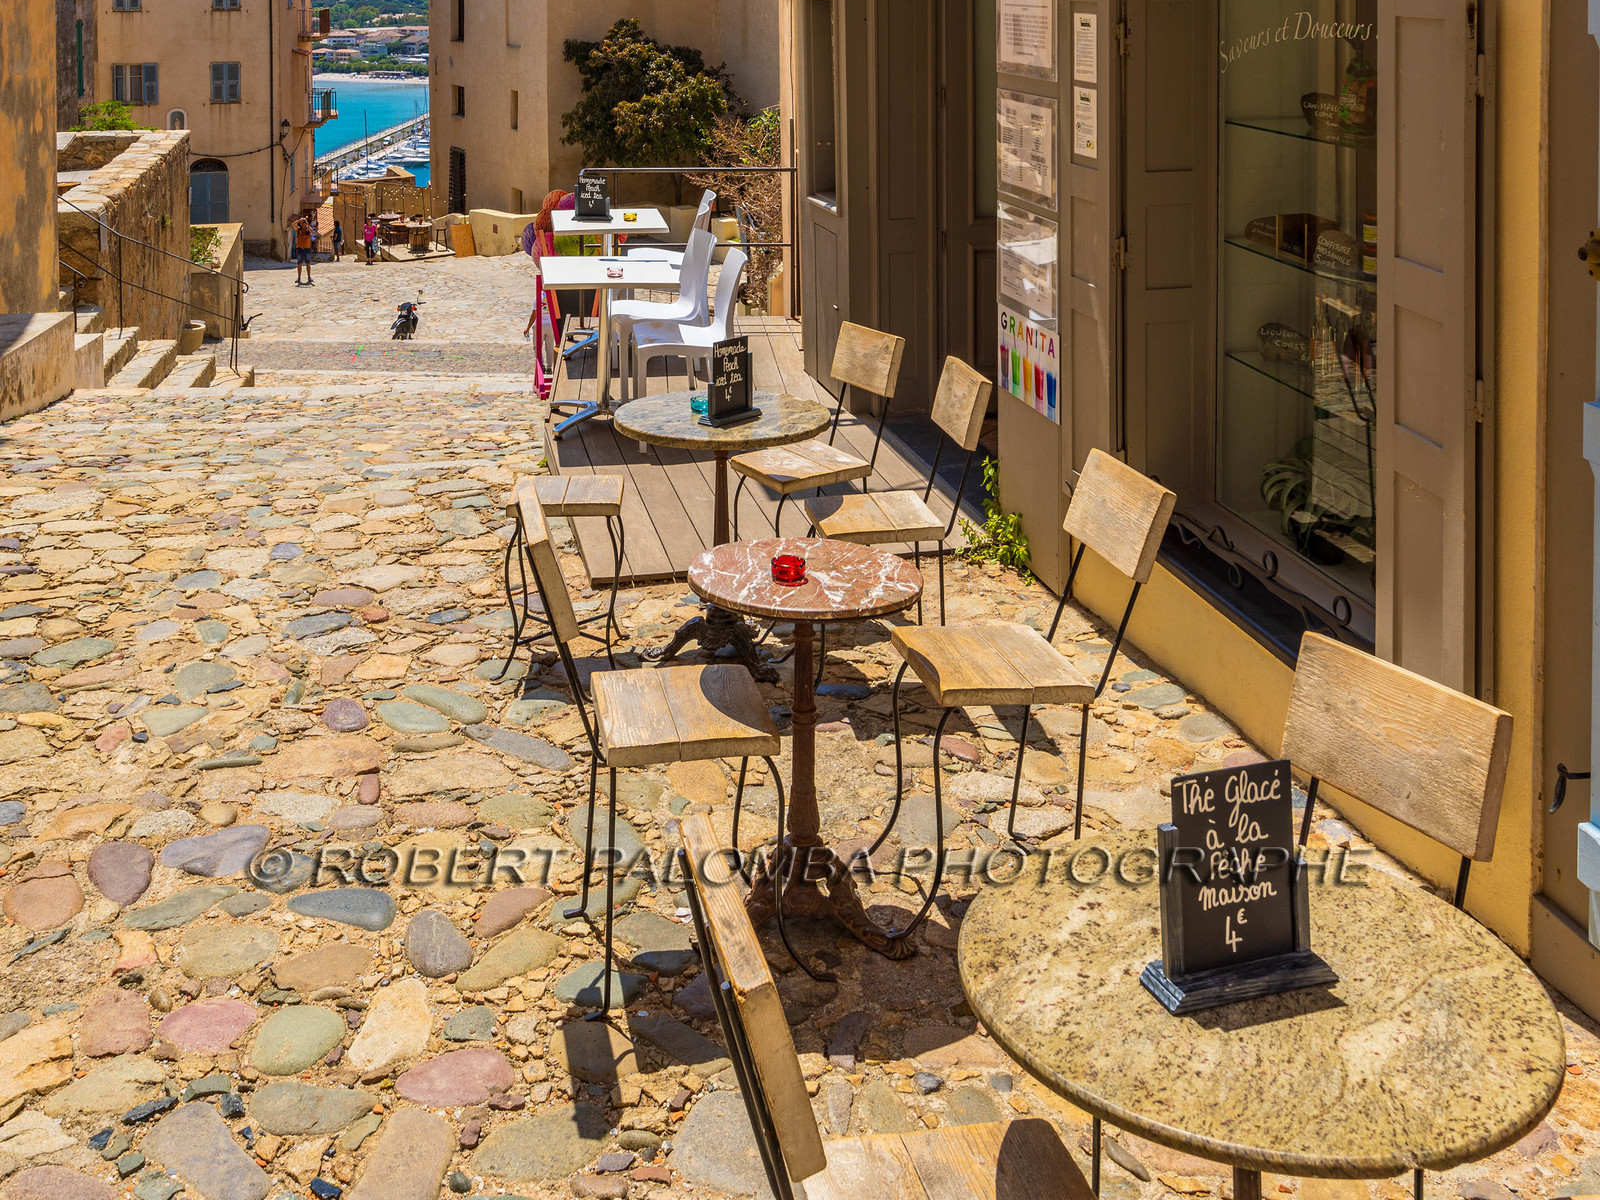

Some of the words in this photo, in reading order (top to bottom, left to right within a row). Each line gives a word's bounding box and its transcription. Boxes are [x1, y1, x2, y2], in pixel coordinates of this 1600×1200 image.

[1218, 27, 1271, 74] Saveurs
[1275, 16, 1290, 43] et
[1293, 11, 1373, 41] Douceurs
[578, 176, 606, 185] Homemade
[585, 184, 601, 192] Peach
[592, 192, 604, 200] tea
[1000, 311, 1056, 359] GRANITA
[713, 341, 747, 359] Homemade
[723, 356, 740, 373] Peach
[714, 373, 728, 387] iced
[729, 371, 744, 384] tea
[1173, 776, 1216, 816] Thé
[1225, 769, 1282, 828] Glacé
[1206, 818, 1225, 851] à
[1235, 812, 1269, 845] la
[1208, 848, 1267, 881] Pêche
